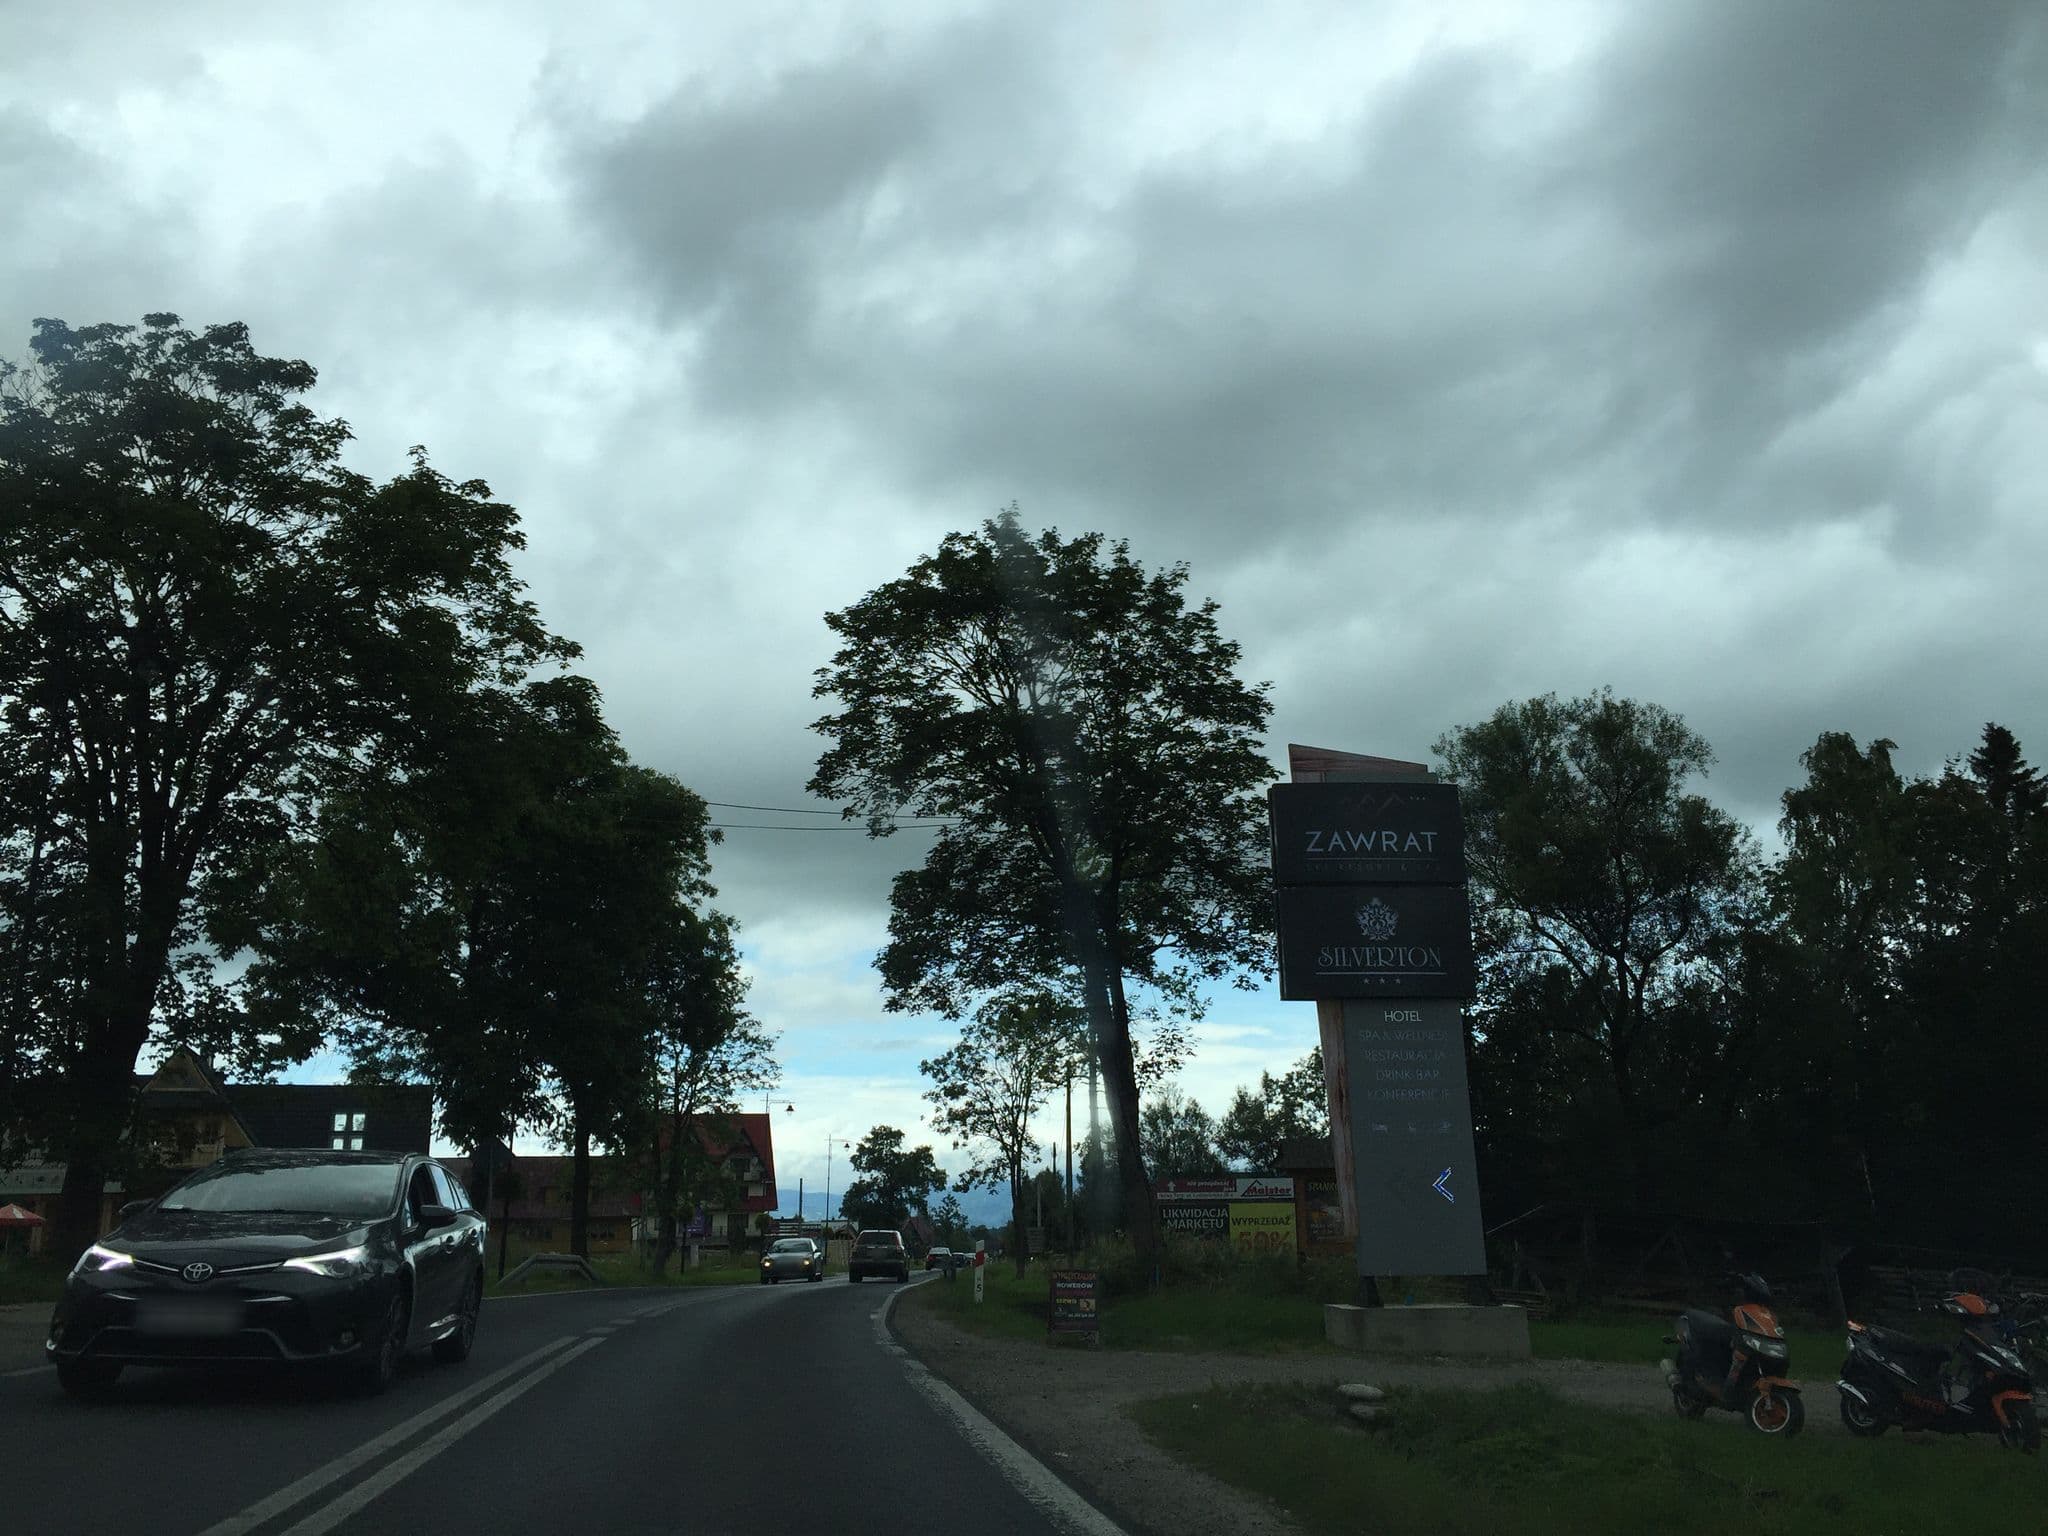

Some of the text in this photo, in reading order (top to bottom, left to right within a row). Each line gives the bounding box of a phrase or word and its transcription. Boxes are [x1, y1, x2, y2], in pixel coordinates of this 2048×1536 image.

[1305, 831, 1438, 852] ZAWRAT
[1318, 947, 1441, 967] SILVERTON
[1384, 1010, 1422, 1021] HOTEL
[1162, 1208, 1229, 1218] LIKWIDACJA
[1167, 1218, 1224, 1230] MARKETU
